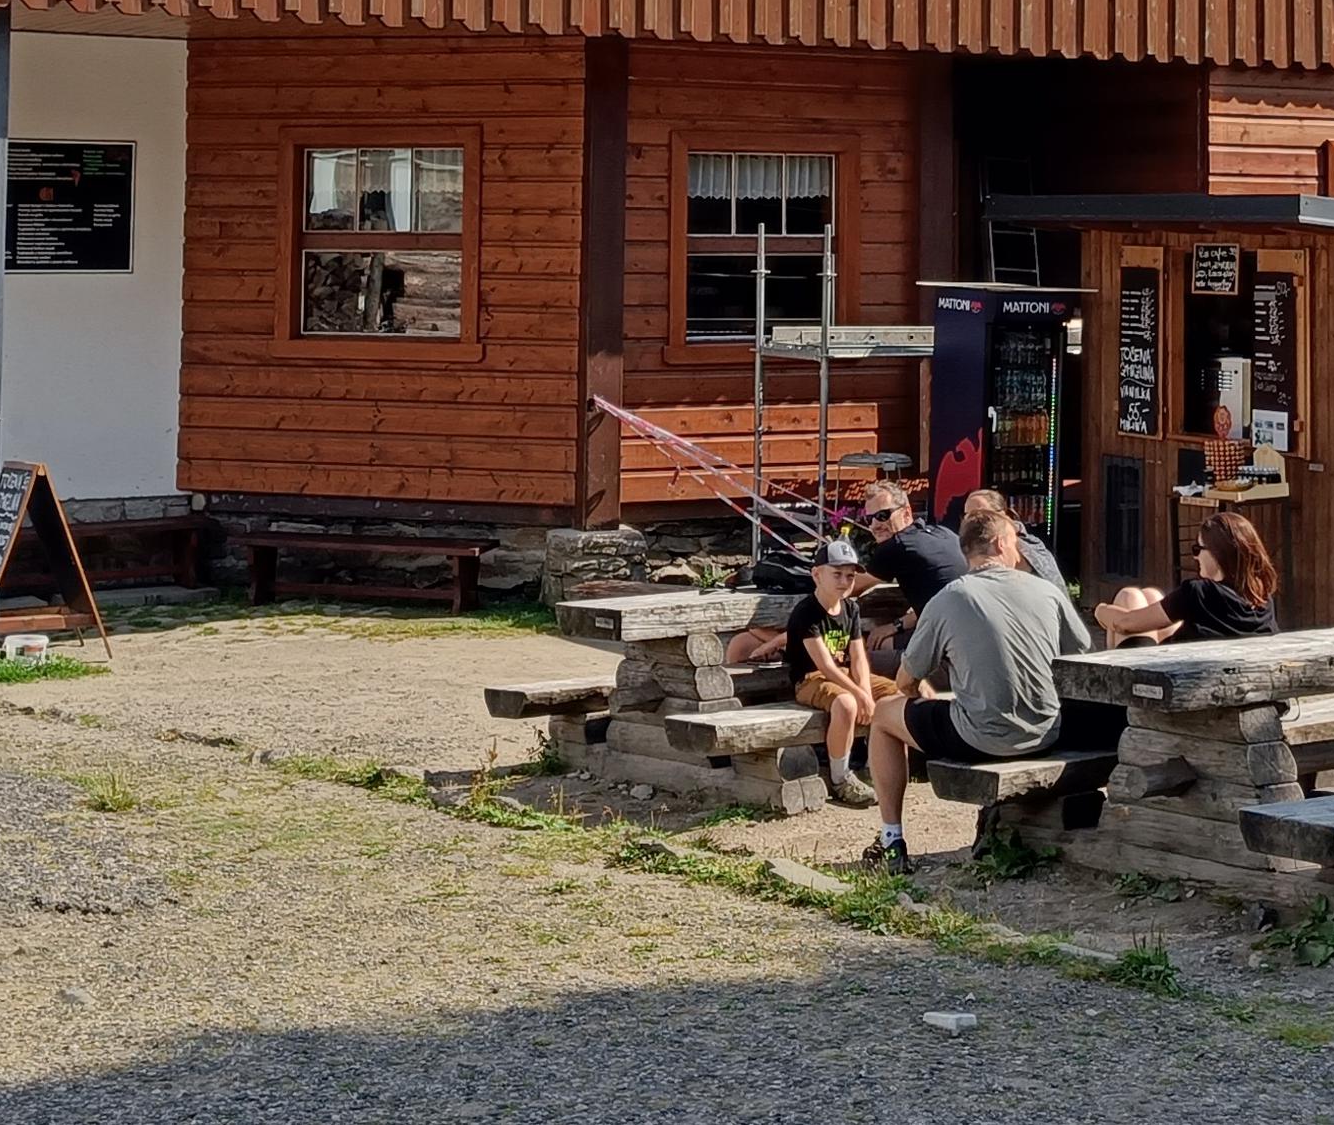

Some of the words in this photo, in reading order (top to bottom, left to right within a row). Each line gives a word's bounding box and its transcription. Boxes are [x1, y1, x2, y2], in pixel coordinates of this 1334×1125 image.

[938, 297, 971, 311] MATTONI
[1003, 301, 1050, 314] MATTONI
[1120, 385, 1151, 402] VANILKA
